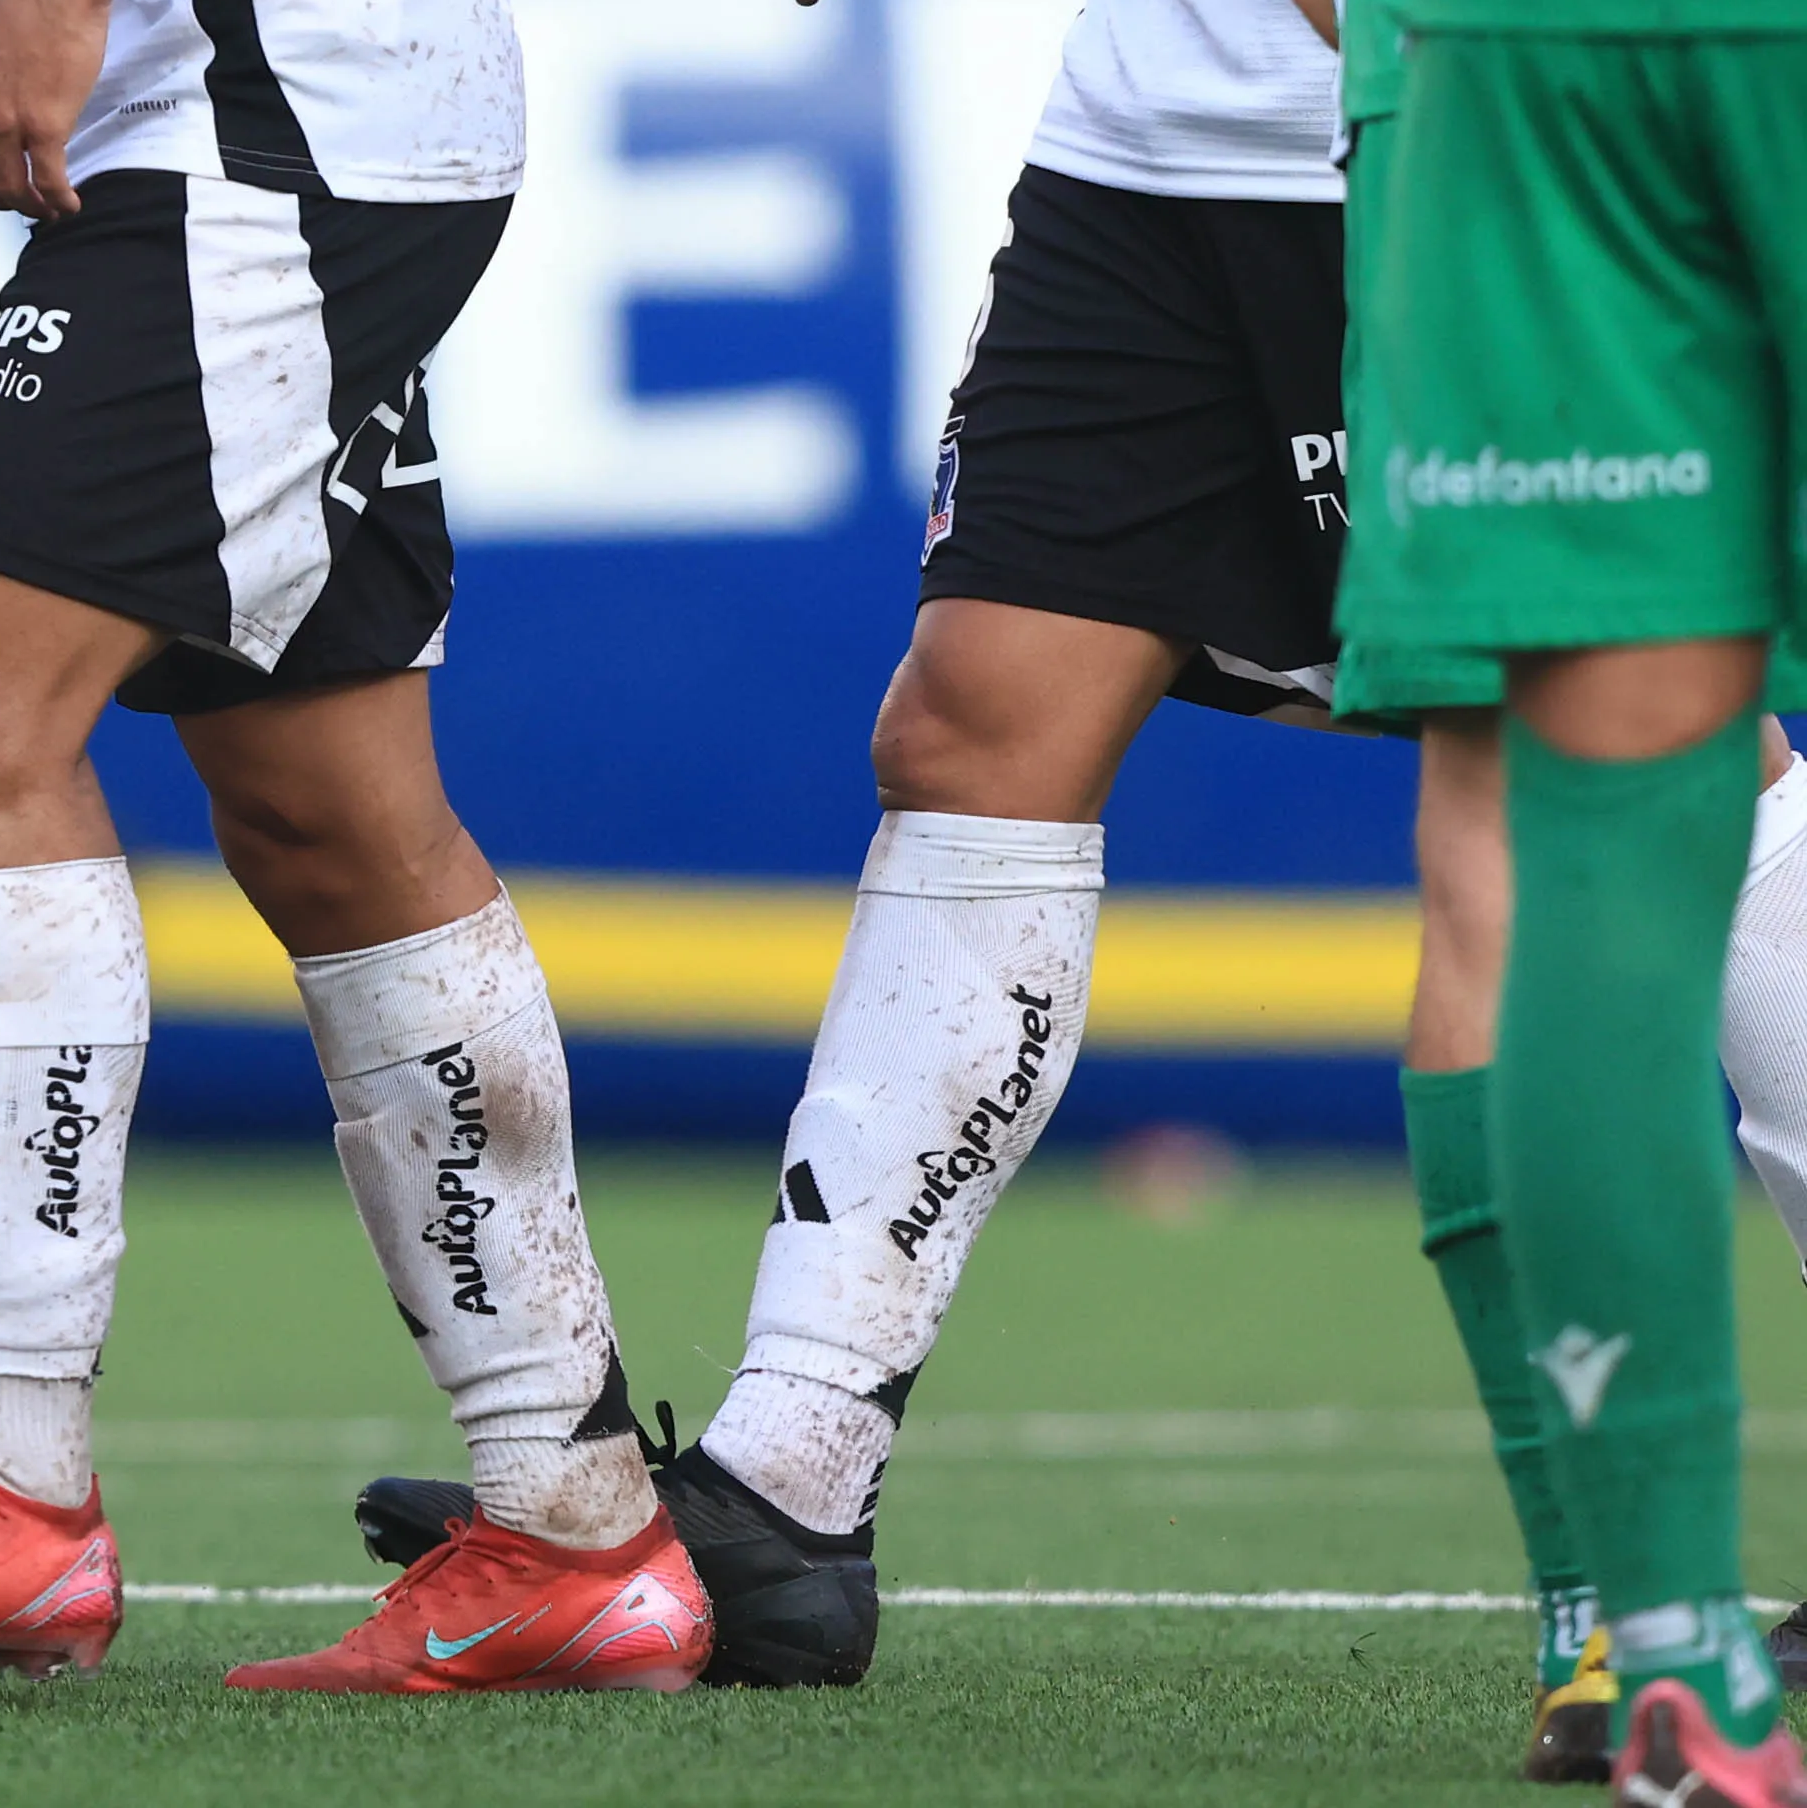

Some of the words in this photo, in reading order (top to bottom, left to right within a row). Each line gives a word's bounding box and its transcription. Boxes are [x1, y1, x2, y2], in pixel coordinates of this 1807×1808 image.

[1407, 444, 1711, 508] defontana
[25, 1045, 99, 1238] AutoPla
[889, 982, 1053, 1261] AutoPlanet
